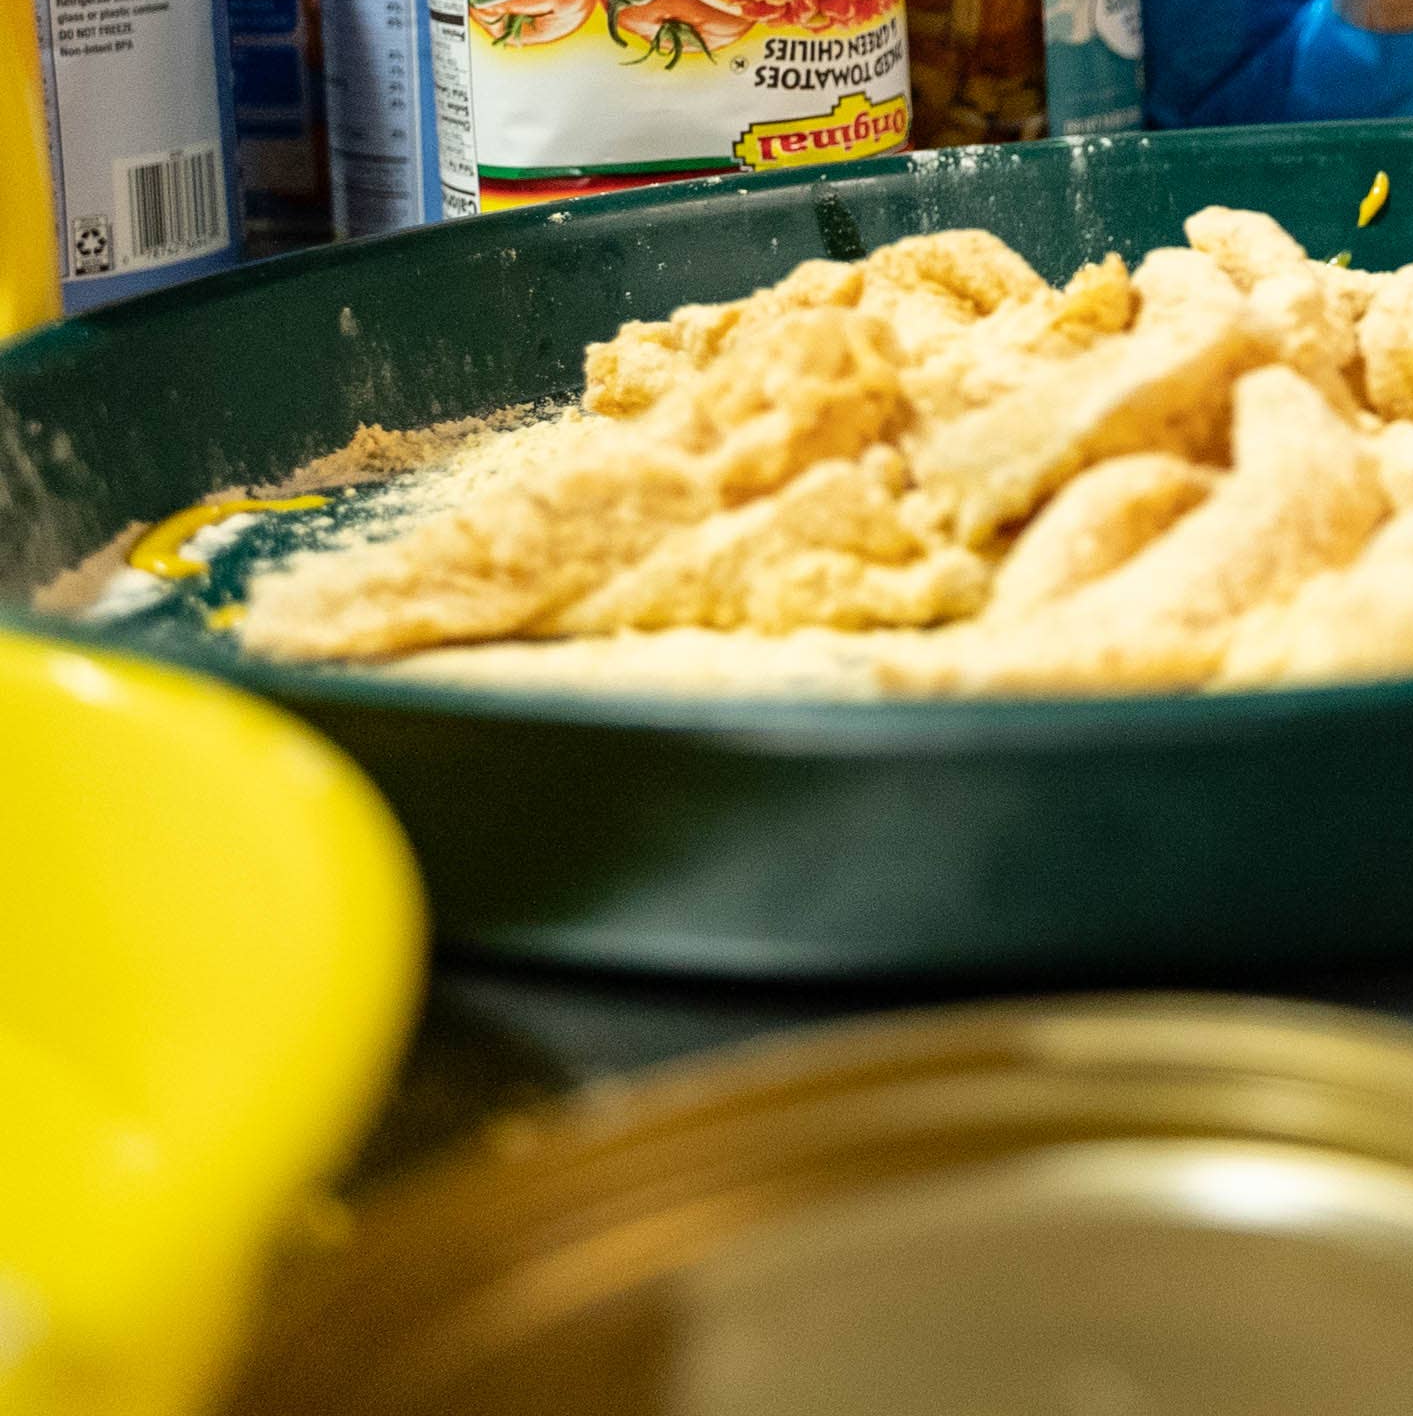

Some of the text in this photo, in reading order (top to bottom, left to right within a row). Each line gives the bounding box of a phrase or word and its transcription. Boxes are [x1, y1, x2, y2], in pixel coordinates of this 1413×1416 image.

[763, 37, 845, 63] CHILIES
[848, 22, 891, 59] GREEN
[754, 61, 874, 90] TOMATOES
[756, 107, 908, 162] Original
